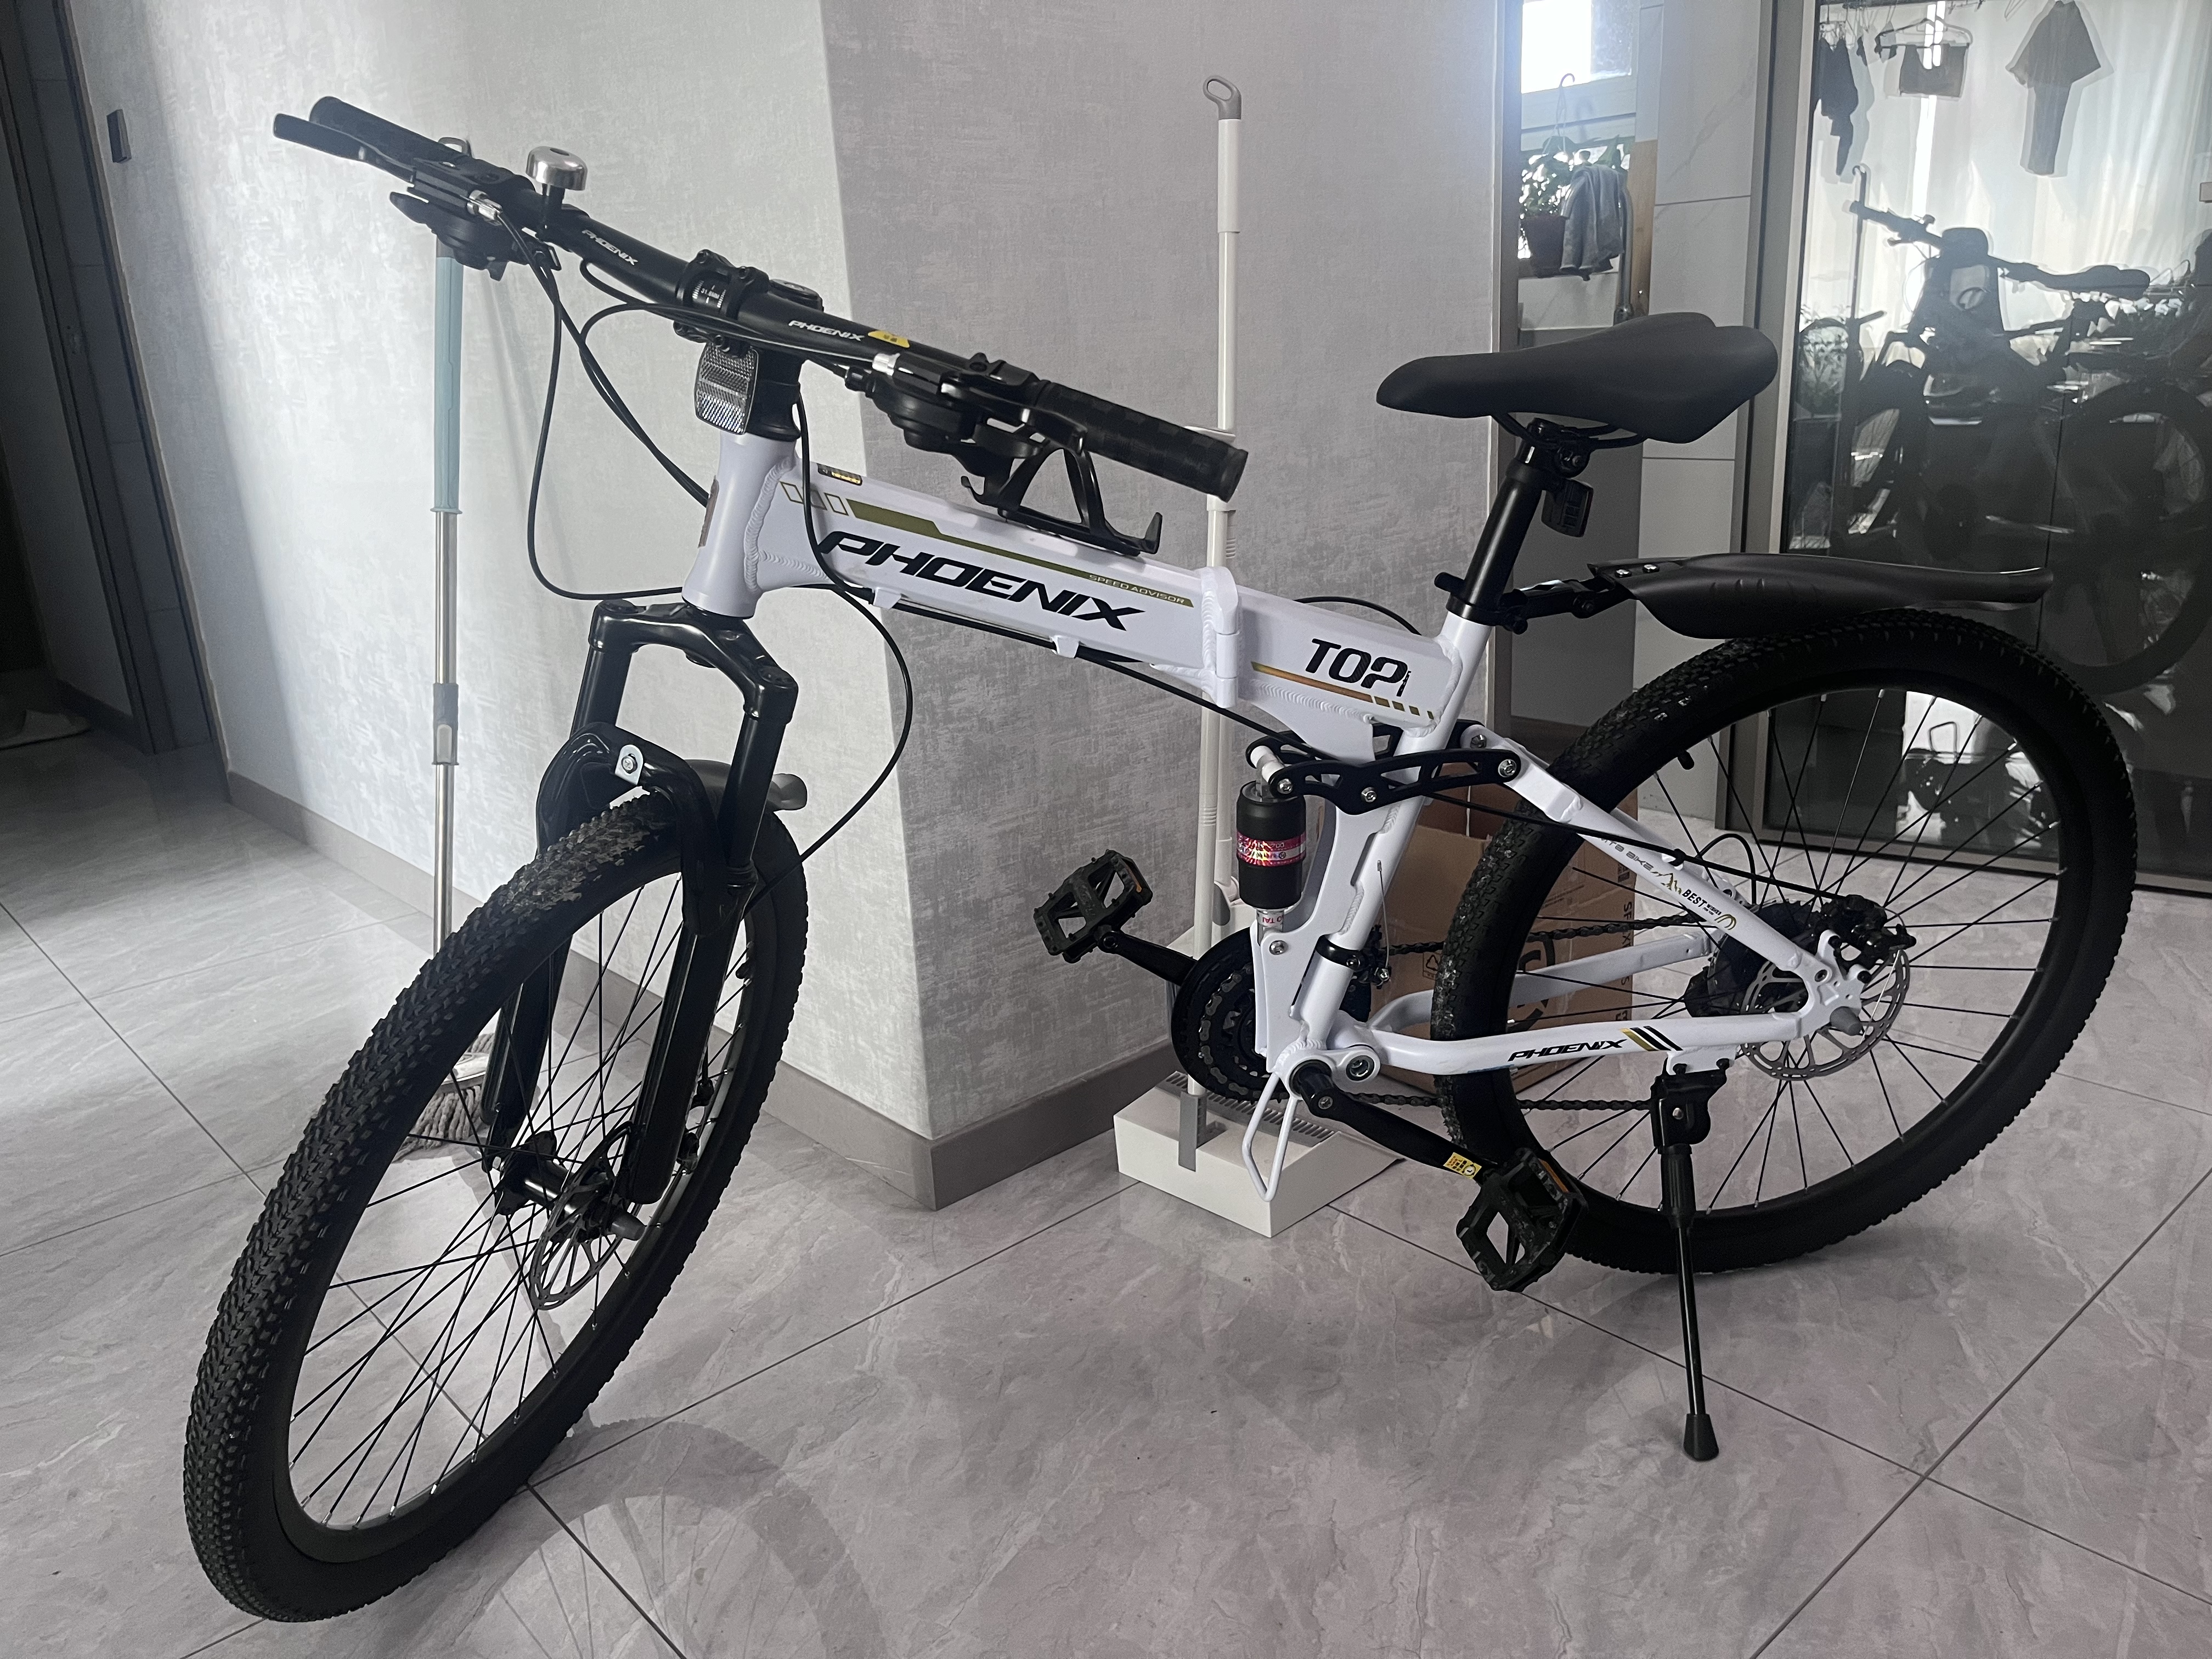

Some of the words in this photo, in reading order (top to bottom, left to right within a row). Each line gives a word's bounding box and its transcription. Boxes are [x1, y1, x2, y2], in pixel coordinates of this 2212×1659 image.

[582, 229, 638, 266] PHOENIX
[788, 319, 865, 342] PHOENIX
[817, 531, 1146, 631] PHOENIX
[1089, 574, 1129, 590] SPEED
[1131, 587, 1185, 604] ADVISOR
[1305, 638, 1408, 689] TOP
[1626, 851, 1654, 871] BIKE
[1682, 889, 1708, 908] BEST
[1507, 1039, 1628, 1062] PHOENIX
